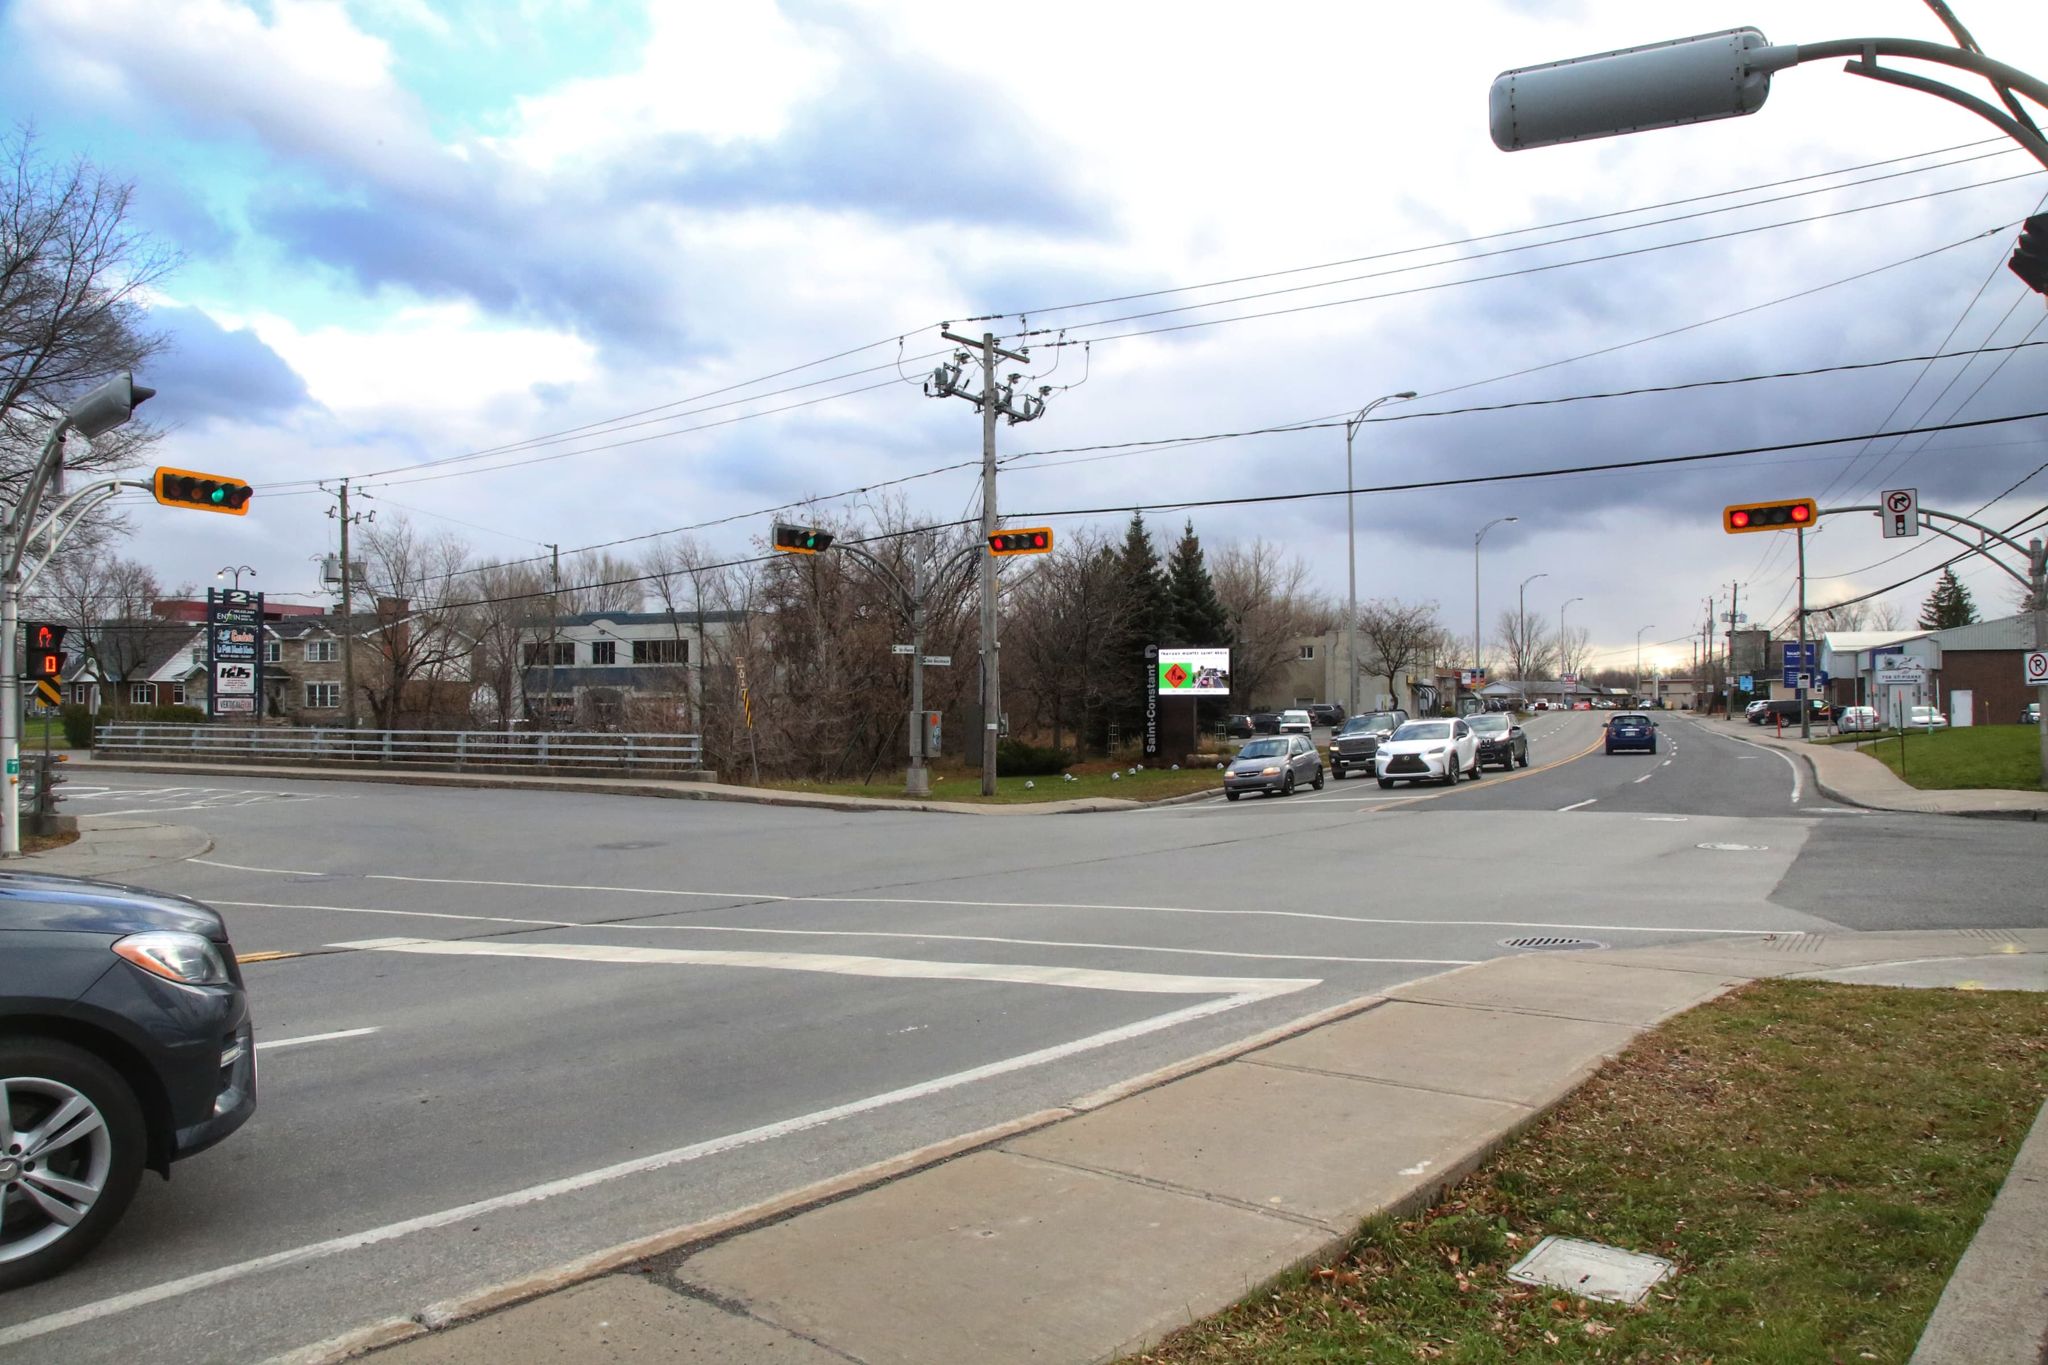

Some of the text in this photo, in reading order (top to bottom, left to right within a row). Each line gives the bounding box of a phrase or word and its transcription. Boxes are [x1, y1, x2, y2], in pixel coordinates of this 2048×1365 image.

[230, 591, 247, 603] 2
[45, 655, 57, 673] 0
[1146, 664, 1156, 752] Saint-Constant
